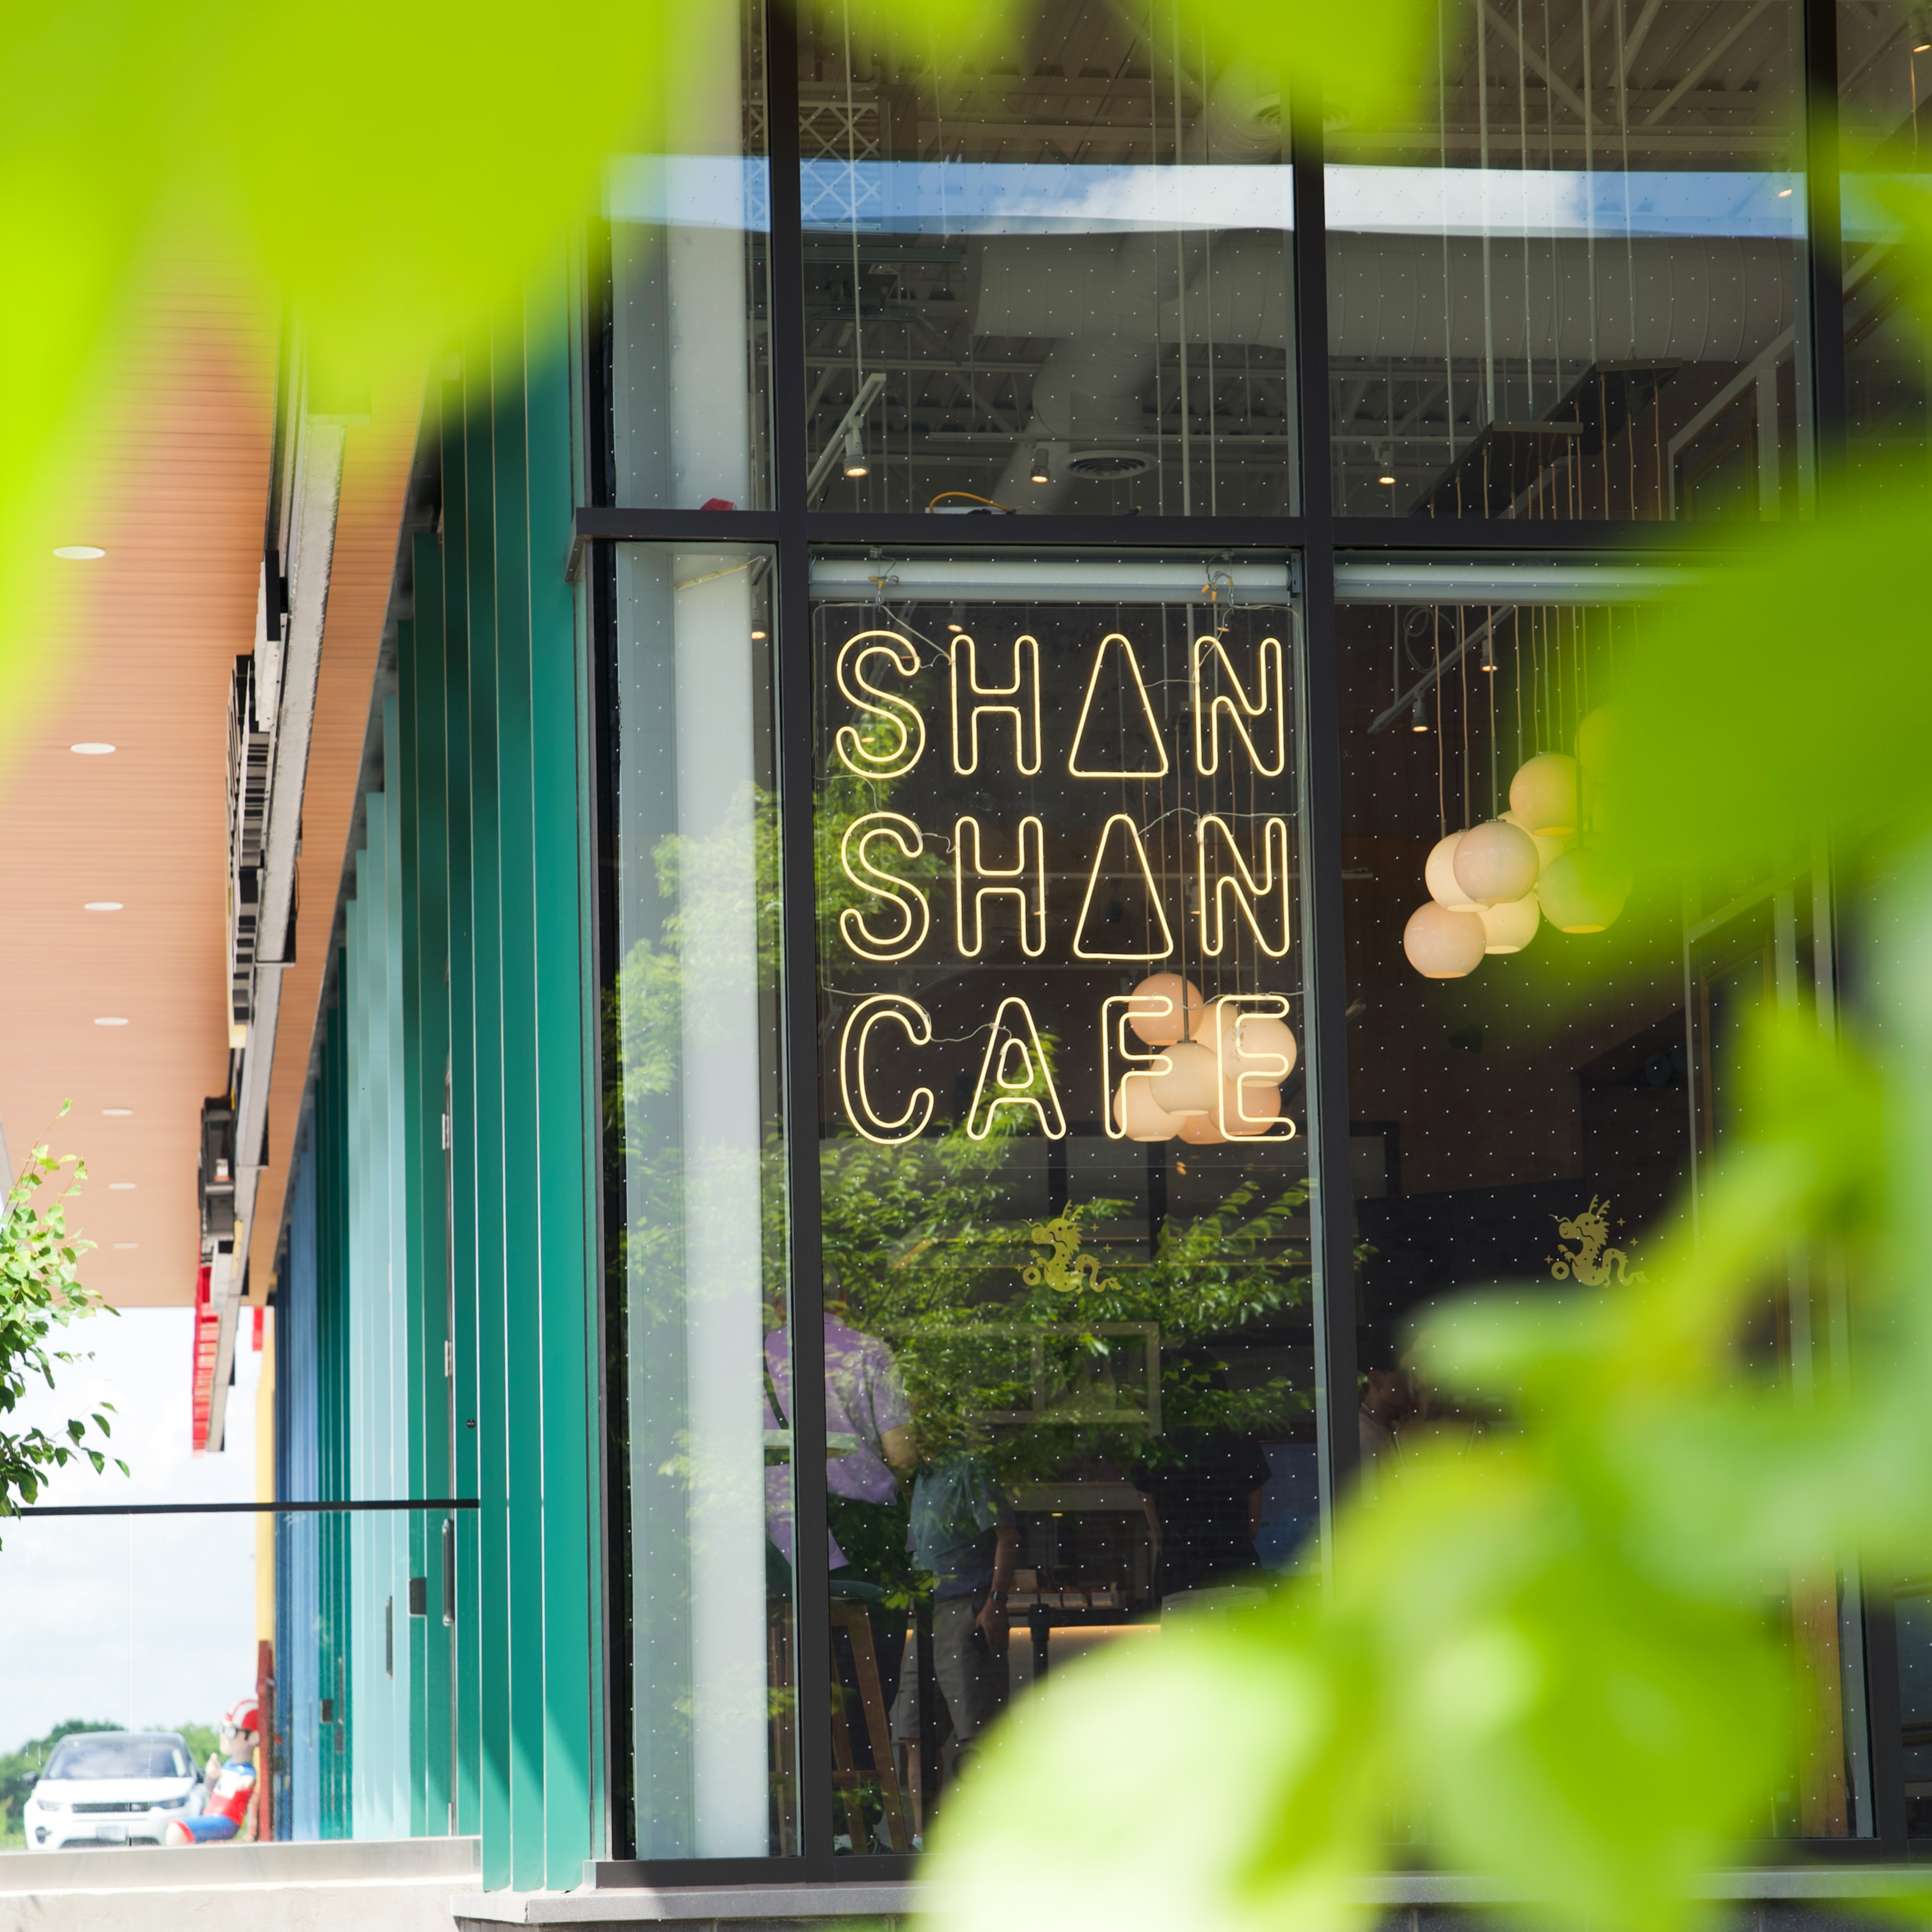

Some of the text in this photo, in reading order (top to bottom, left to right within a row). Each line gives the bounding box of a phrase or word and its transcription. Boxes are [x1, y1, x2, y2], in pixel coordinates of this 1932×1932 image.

[836, 630, 1285, 779] SHAN
[840, 812, 1290, 961] SHAN
[840, 994, 1296, 1145] CAFE
